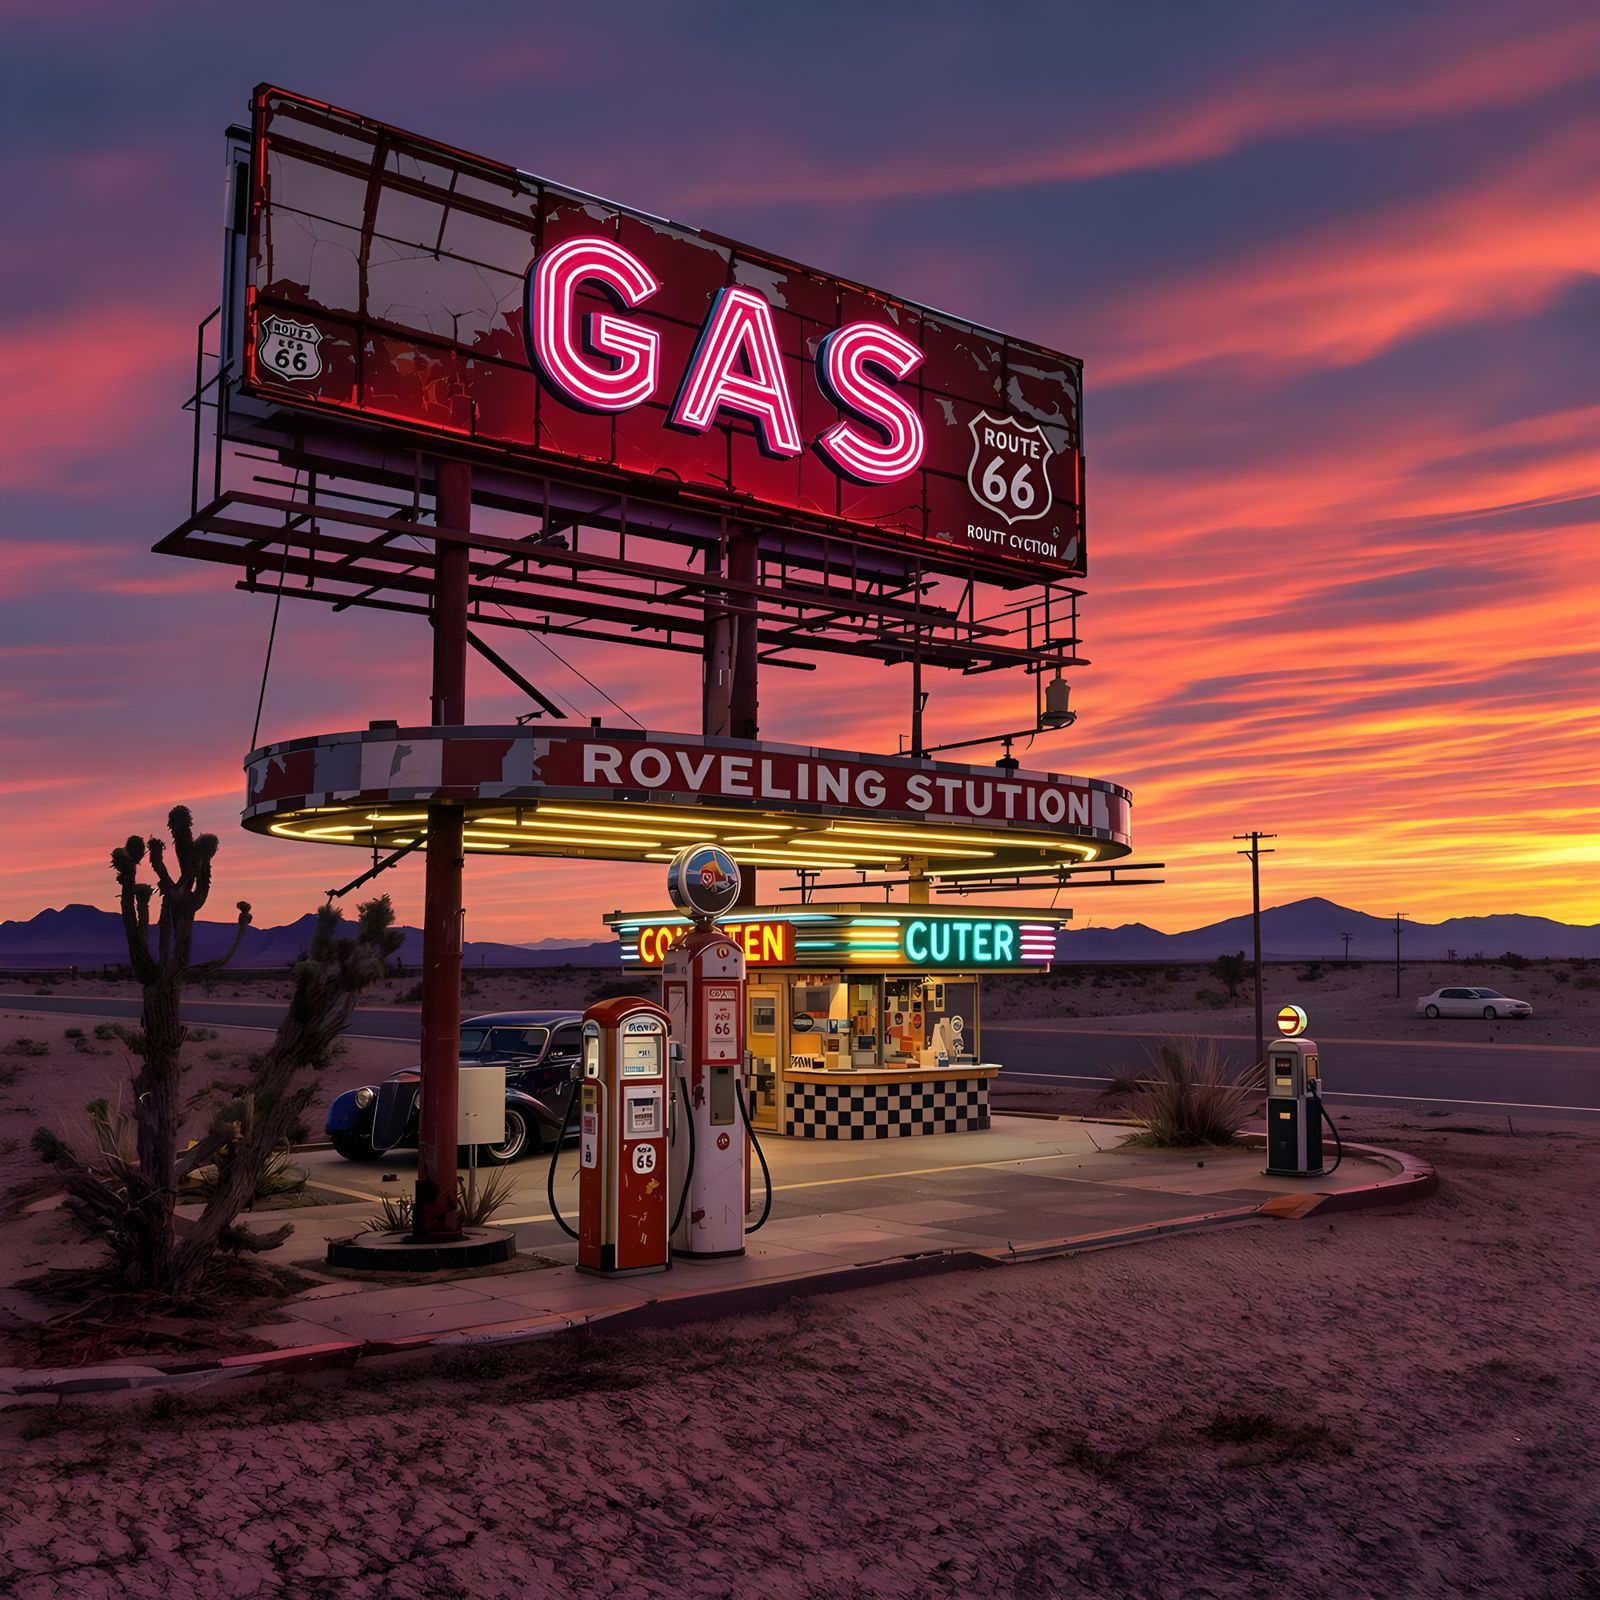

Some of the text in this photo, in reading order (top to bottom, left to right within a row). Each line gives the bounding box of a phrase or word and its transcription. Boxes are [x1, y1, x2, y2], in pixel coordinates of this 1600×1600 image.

[274, 349, 308, 372] 66
[524, 235, 927, 486] GAS
[984, 427, 1041, 460] ROUTE
[982, 455, 1035, 510] 66
[967, 524, 1006, 545] ROUTT
[582, 743, 1090, 826] ROVELING STUTION
[905, 920, 1014, 962] CUTER
[714, 1022, 731, 1036] 66
